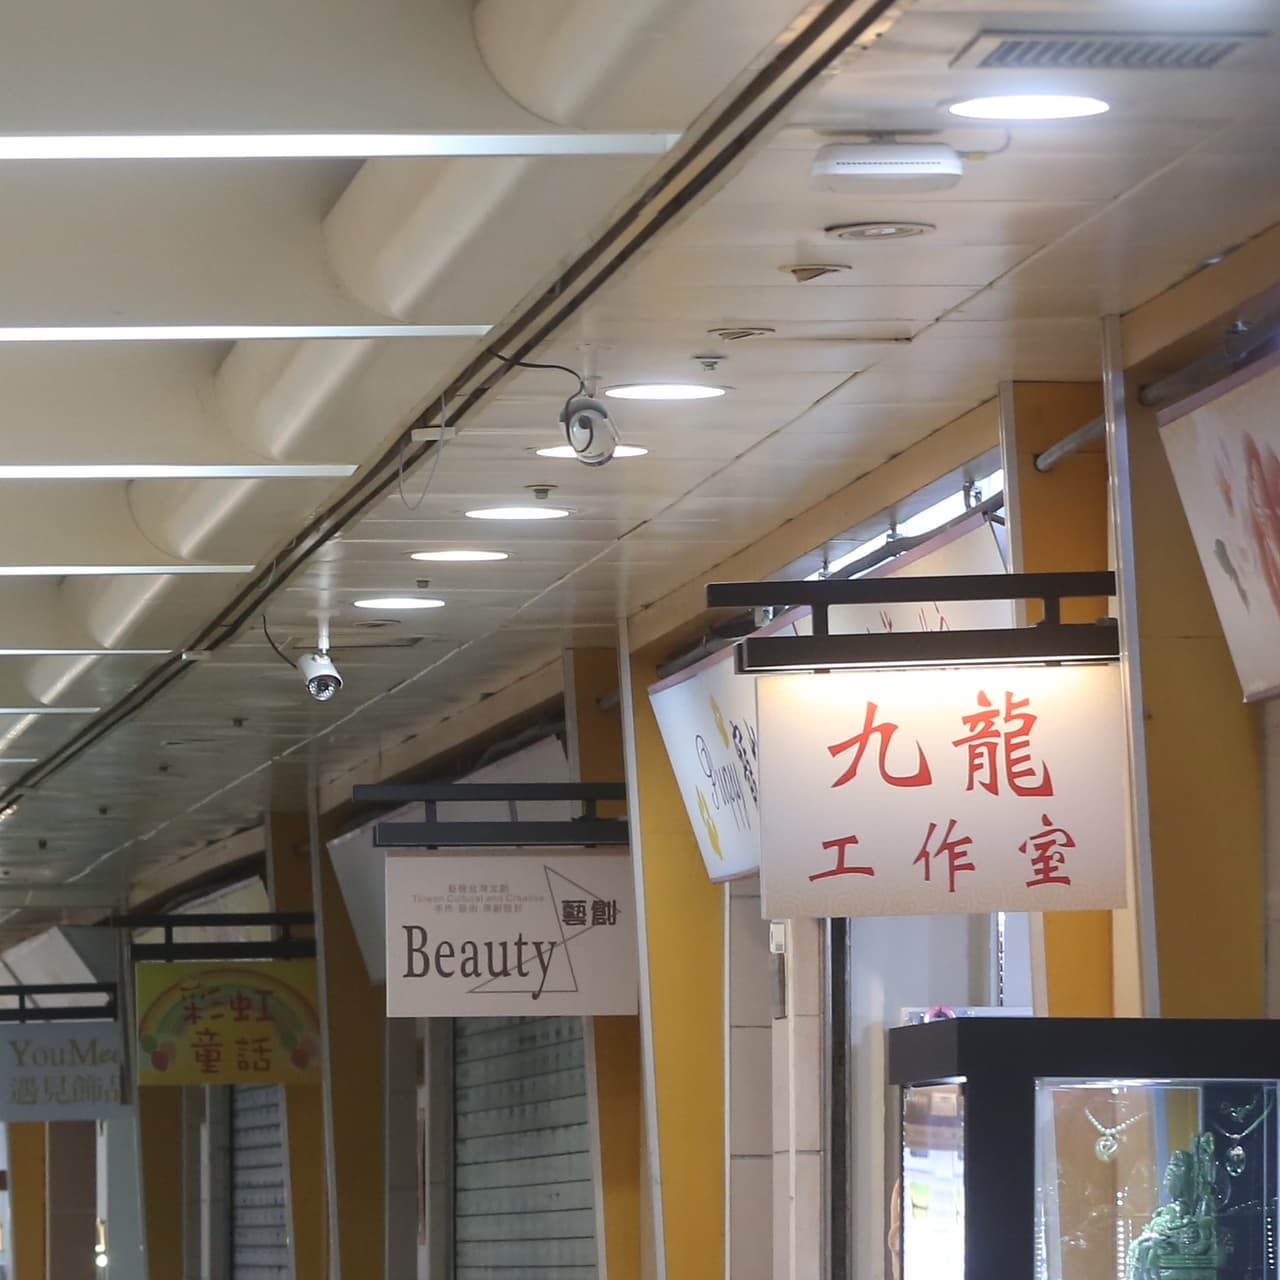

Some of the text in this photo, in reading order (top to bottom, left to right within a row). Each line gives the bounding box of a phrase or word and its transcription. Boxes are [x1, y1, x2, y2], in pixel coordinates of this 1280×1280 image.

[827, 689, 1054, 797] 九龍
[808, 814, 1077, 894] 工作室
[401, 925, 558, 1000] Beauty
[180, 976, 275, 1025] 彩虹
[191, 1026, 273, 1074] 童話
